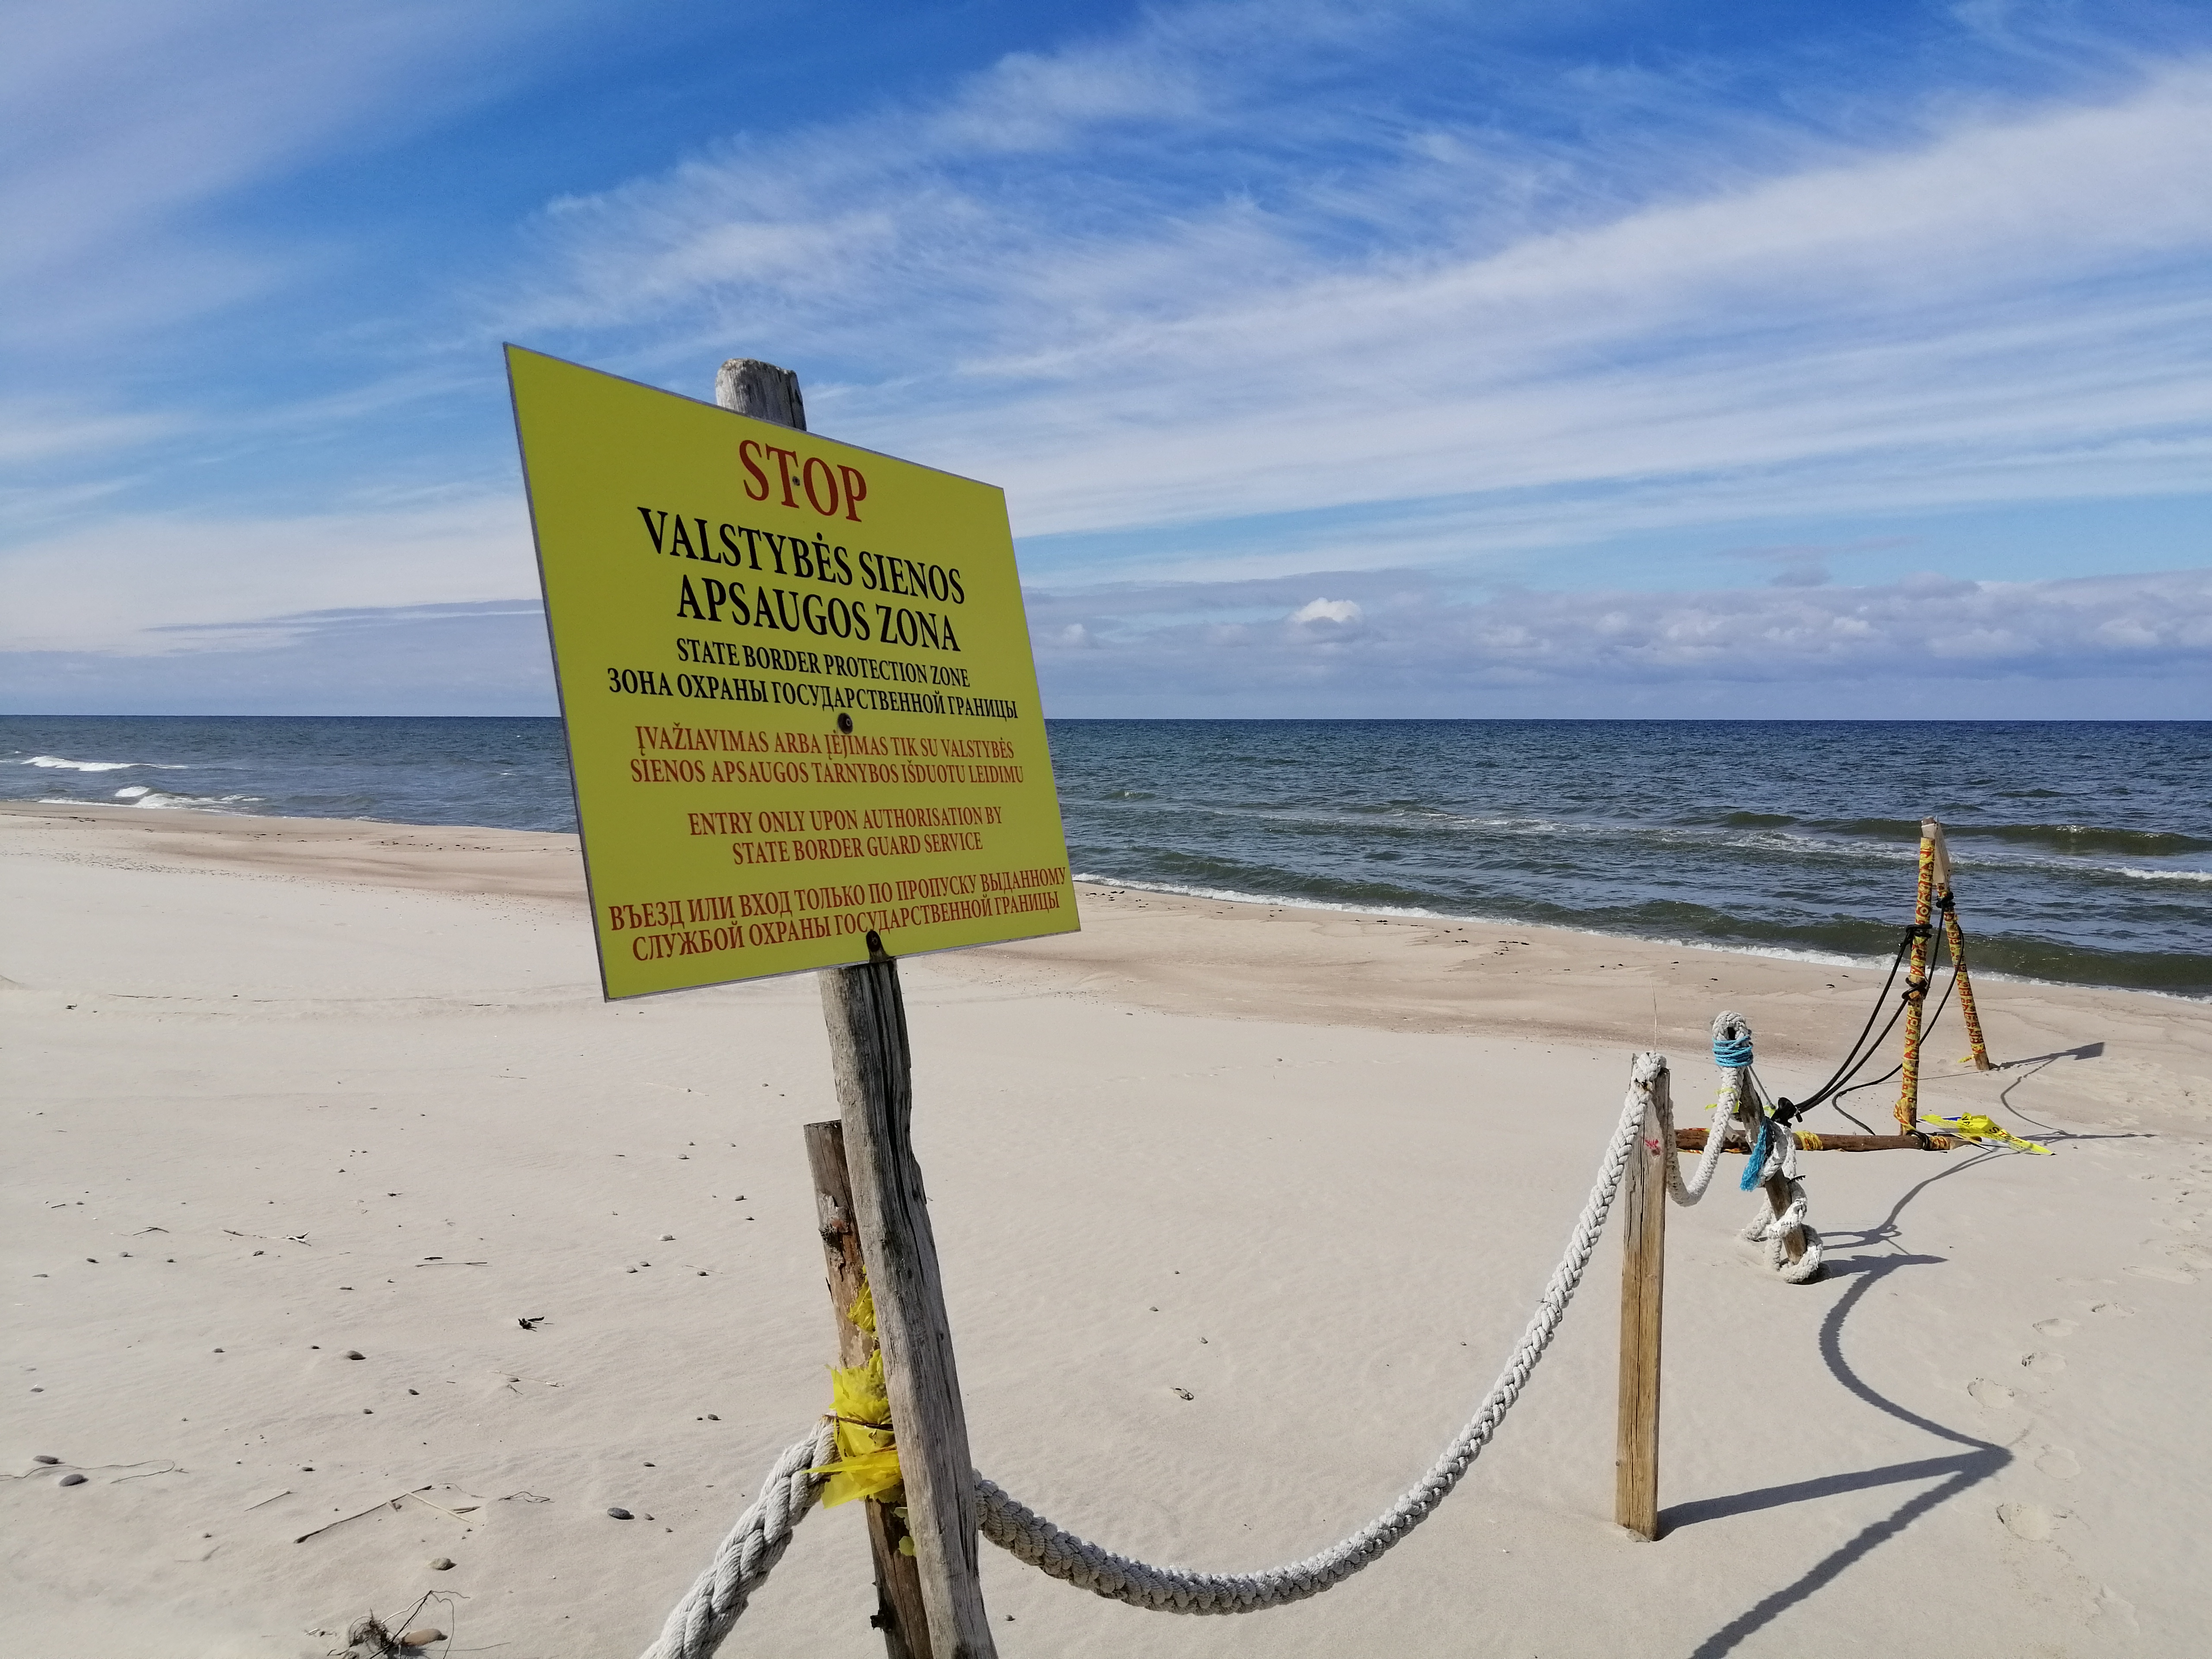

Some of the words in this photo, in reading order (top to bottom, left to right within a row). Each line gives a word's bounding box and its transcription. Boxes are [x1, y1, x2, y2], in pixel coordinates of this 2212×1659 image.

[738, 439, 867, 523] STOP
[636, 506, 853, 586] VALSTYBĖS
[858, 550, 965, 604] SIENOS
[676, 574, 871, 641] APSAUGOS
[875, 603, 961, 652] ZONA
[676, 637, 740, 666] STATE
[741, 645, 822, 674] BORDER
[822, 653, 928, 684] PROTECTION
[929, 664, 970, 687] ZONE
[607, 667, 674, 696] ЗОНА
[677, 673, 769, 703] ОХРАНЫ
[770, 681, 946, 714] ГОСУДАРСТВЕННОЙ
[946, 696, 1019, 722] ГРАНИЦЫ
[634, 721, 769, 756] ĮVAŽIAVIMAS
[774, 731, 823, 753] ARBA
[890, 736, 919, 757] TIK
[919, 737, 938, 757] SU
[940, 736, 1014, 759] VALSTYBĖS
[630, 758, 706, 783] SIENOS
[711, 760, 809, 783] APSAUGOS
[810, 762, 899, 783] TARNYBOS
[900, 759, 966, 783] IŠDUOTU
[967, 765, 1023, 783] LEIDIMU
[687, 811, 753, 836] ENTRY
[758, 810, 805, 833] ONLY
[808, 809, 858, 831] UPON
[862, 806, 983, 829] AUTHORISATION
[984, 806, 1002, 824] BY
[732, 840, 790, 865] STATE
[791, 837, 865, 861] BORDER
[866, 834, 921, 857] GUARD
[923, 831, 983, 853] SERVICE
[607, 900, 685, 931] ВЪЕЗД
[686, 895, 736, 922] ИЛИ
[737, 890, 793, 918] ВХОД
[793, 884, 865, 911] ТОЛЬКО
[867, 881, 893, 904] ПО
[894, 874, 976, 901] ПРОПУСКУ
[979, 866, 1066, 898] ВЫДАННОМУ
[632, 920, 745, 961] СЛУЖБОЙ
[748, 915, 832, 946] ОХРАНЫ
[833, 897, 993, 935] ГОСУДАРСТВЕННОЙ
[993, 890, 1060, 915] ГРАНИЦЫ
[1989, 1126, 2023, 1144] STOP
